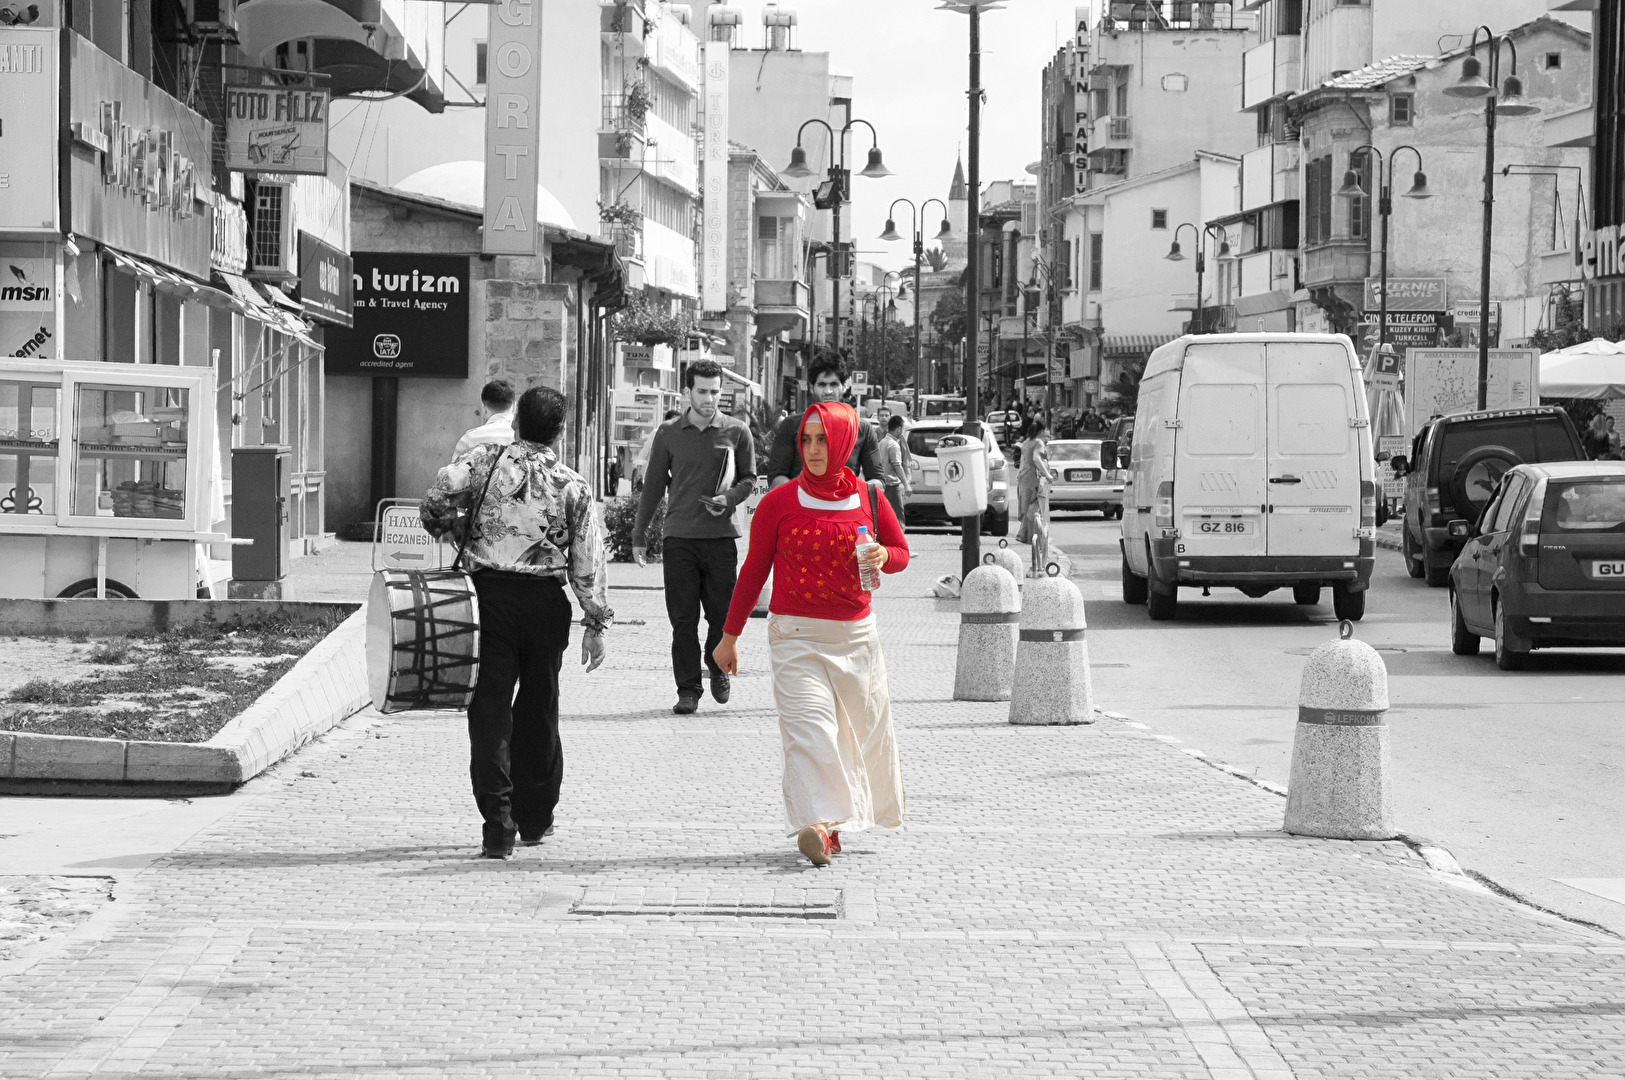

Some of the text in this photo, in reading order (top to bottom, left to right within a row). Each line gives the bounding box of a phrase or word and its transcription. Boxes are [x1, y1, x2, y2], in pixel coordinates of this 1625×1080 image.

[1077, 20, 1088, 93] ALTIN
[228, 91, 324, 123] FOTO FİLİZ
[709, 94, 723, 160] TÜRK
[372, 267, 460, 293] turizm
[1, 286, 49, 301] msn
[368, 298, 377, 307] &
[381, 298, 410, 308] Travel
[413, 299, 448, 311] Agency
[1364, 313, 1435, 324] ÇINR TELEFON
[9, 326, 52, 358] ernet
[395, 361, 414, 369] agent
[1382, 356, 1394, 370] P
[856, 373, 863, 383] P
[1450, 408, 1554, 422] BIGHORN
[388, 515, 423, 528] HAYA
[1200, 522, 1245, 533] GZ 816
[1177, 544, 1186, 553] B
